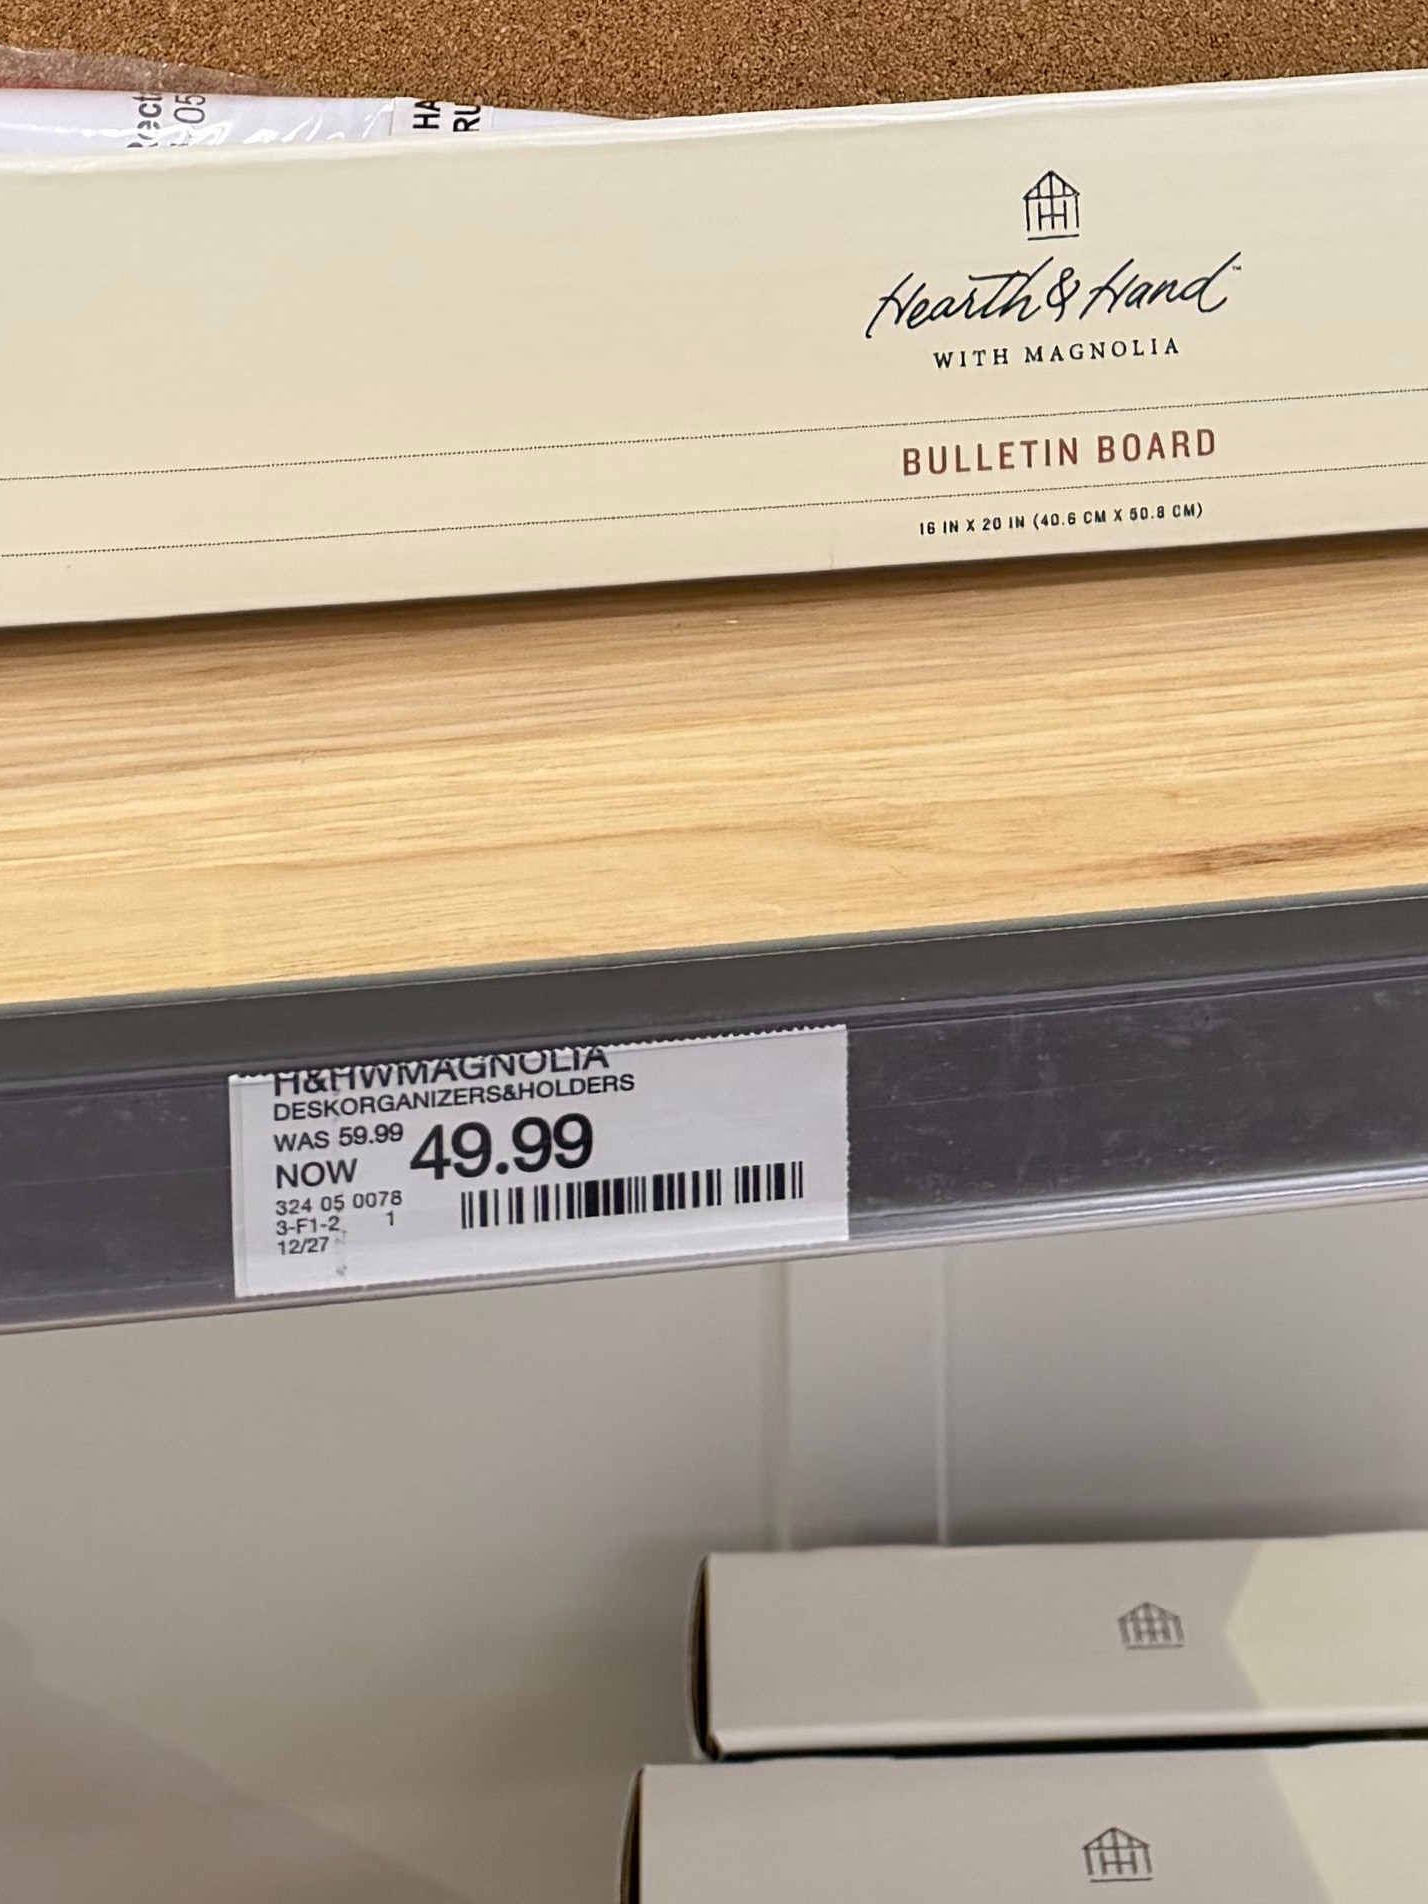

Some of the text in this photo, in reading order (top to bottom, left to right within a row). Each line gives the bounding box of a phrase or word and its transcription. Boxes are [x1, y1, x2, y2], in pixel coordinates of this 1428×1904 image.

[865, 256, 1055, 339] Hearth
[1045, 267, 1080, 322] &
[933, 337, 1180, 369] WITH MAGNOLIA
[902, 428, 1217, 477] BULLETIN BOARD
[919, 521, 936, 536] 16
[942, 519, 960, 534] IN
[965, 518, 976, 533] X
[981, 517, 1003, 531] 20
[1008, 514, 1026, 529] IN
[1032, 511, 1077, 530] (40.6
[1083, 509, 1108, 525] CM
[1113, 507, 1124, 522] X
[1172, 502, 1204, 519] CM)
[274, 1048, 610, 1097] H&HWMAGNOLIA
[273, 1073, 636, 1122] DESKORGANIZERS&HOLDERS
[273, 1122, 404, 1152] WAS 59.99
[276, 1112, 595, 1189] NOW 49.99
[275, 1190, 403, 1216] 324 05 0078
[275, 1210, 395, 1236] 3-F1-2 1
[277, 1236, 330, 1255] 12/27
